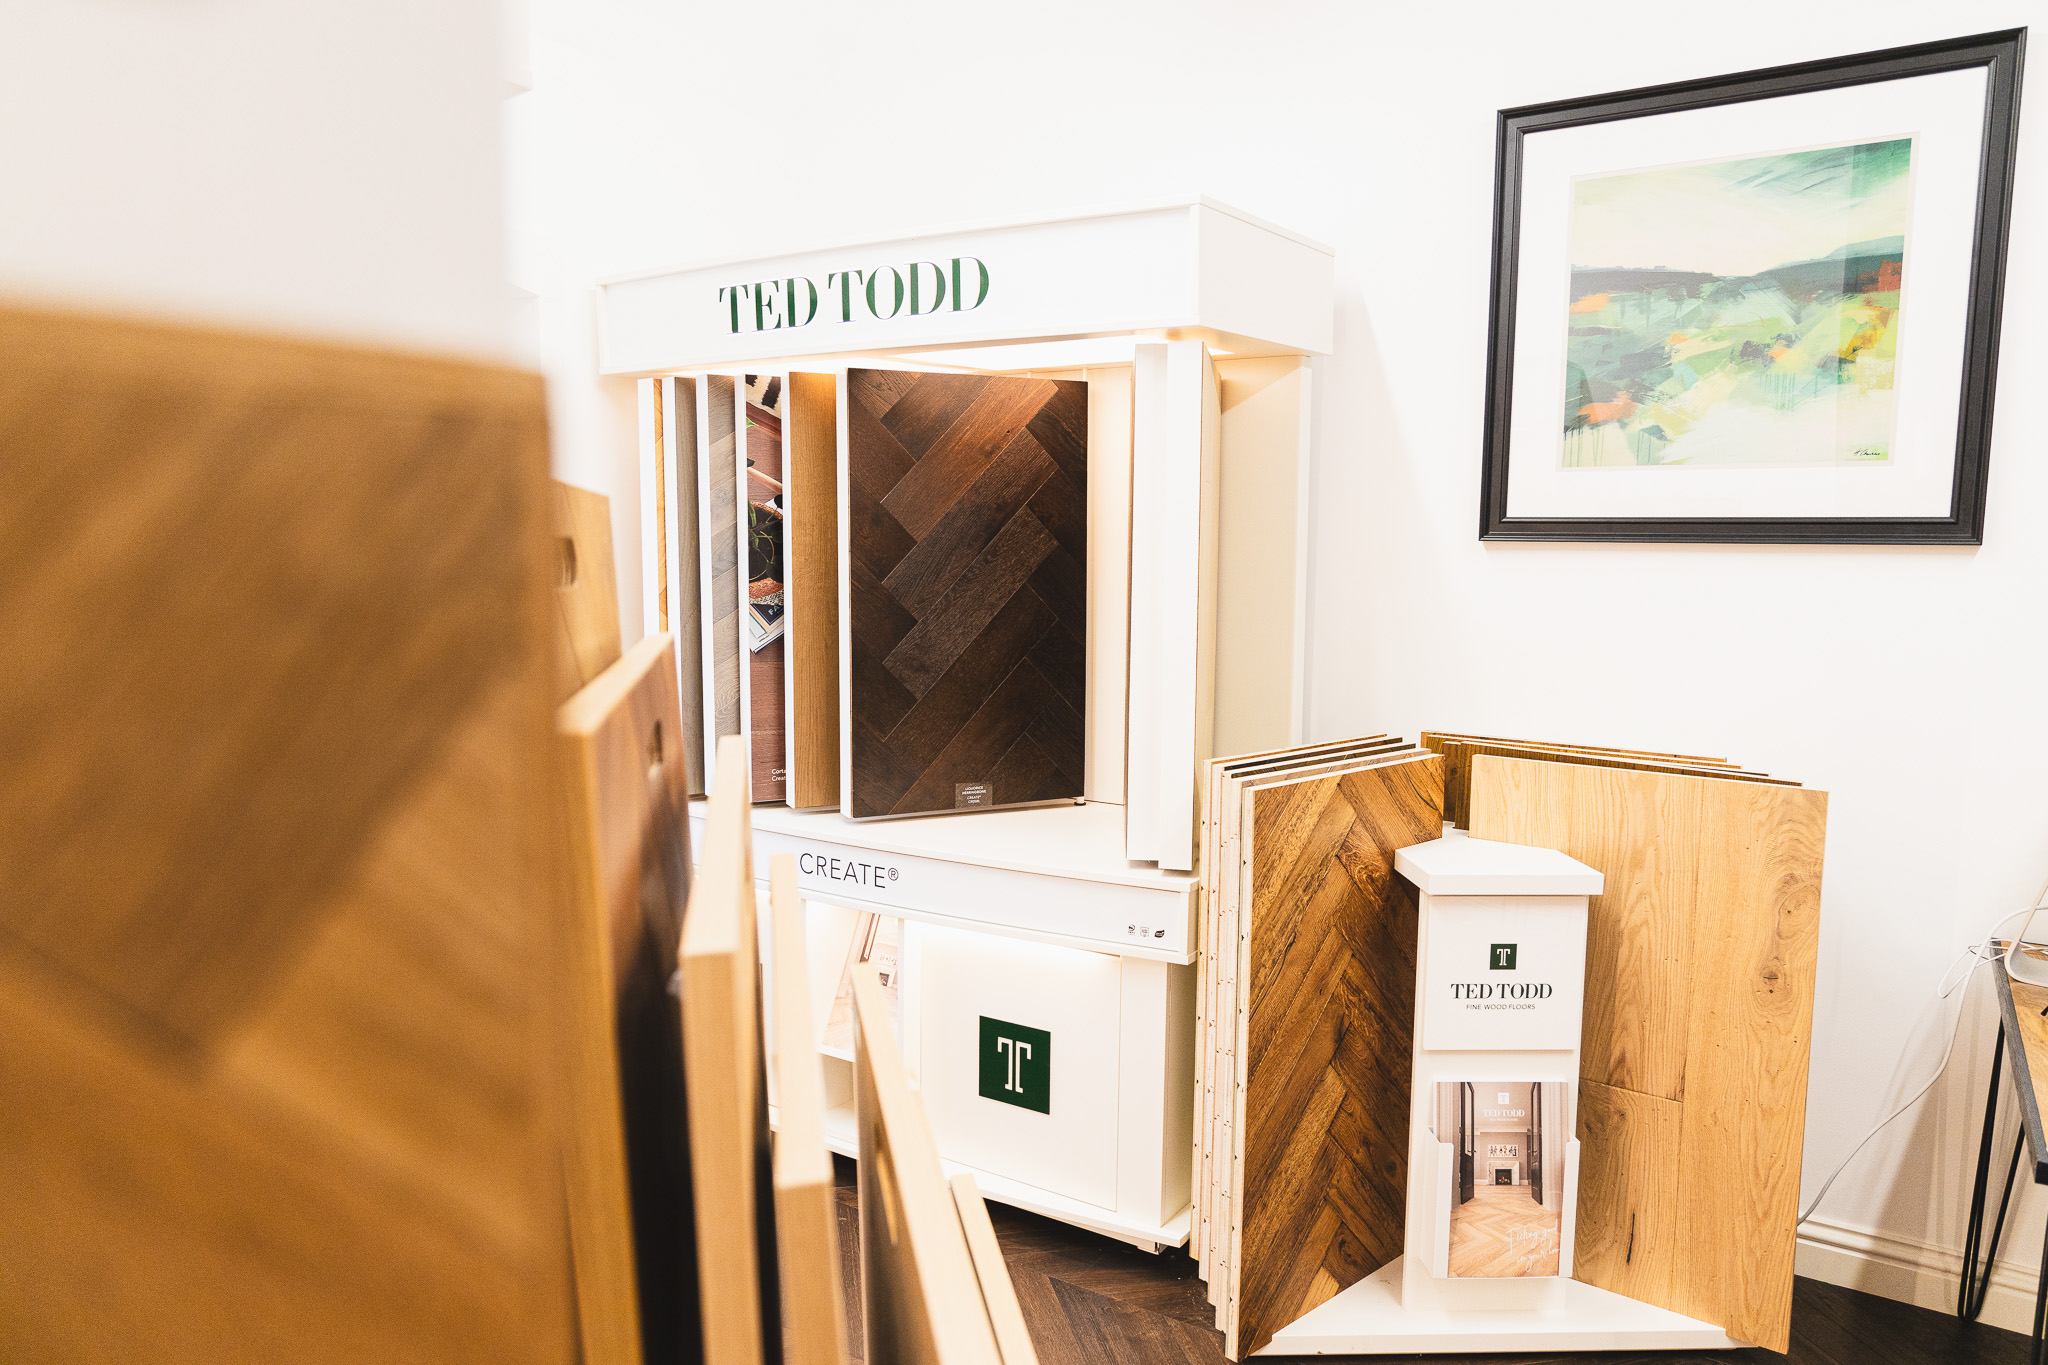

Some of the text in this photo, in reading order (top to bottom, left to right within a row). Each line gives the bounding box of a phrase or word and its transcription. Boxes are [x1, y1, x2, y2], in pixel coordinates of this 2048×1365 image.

[719, 256, 989, 335] TED TODD
[1450, 983, 1553, 1000] TED TODD
[1501, 1108, 1526, 1117] TODD
